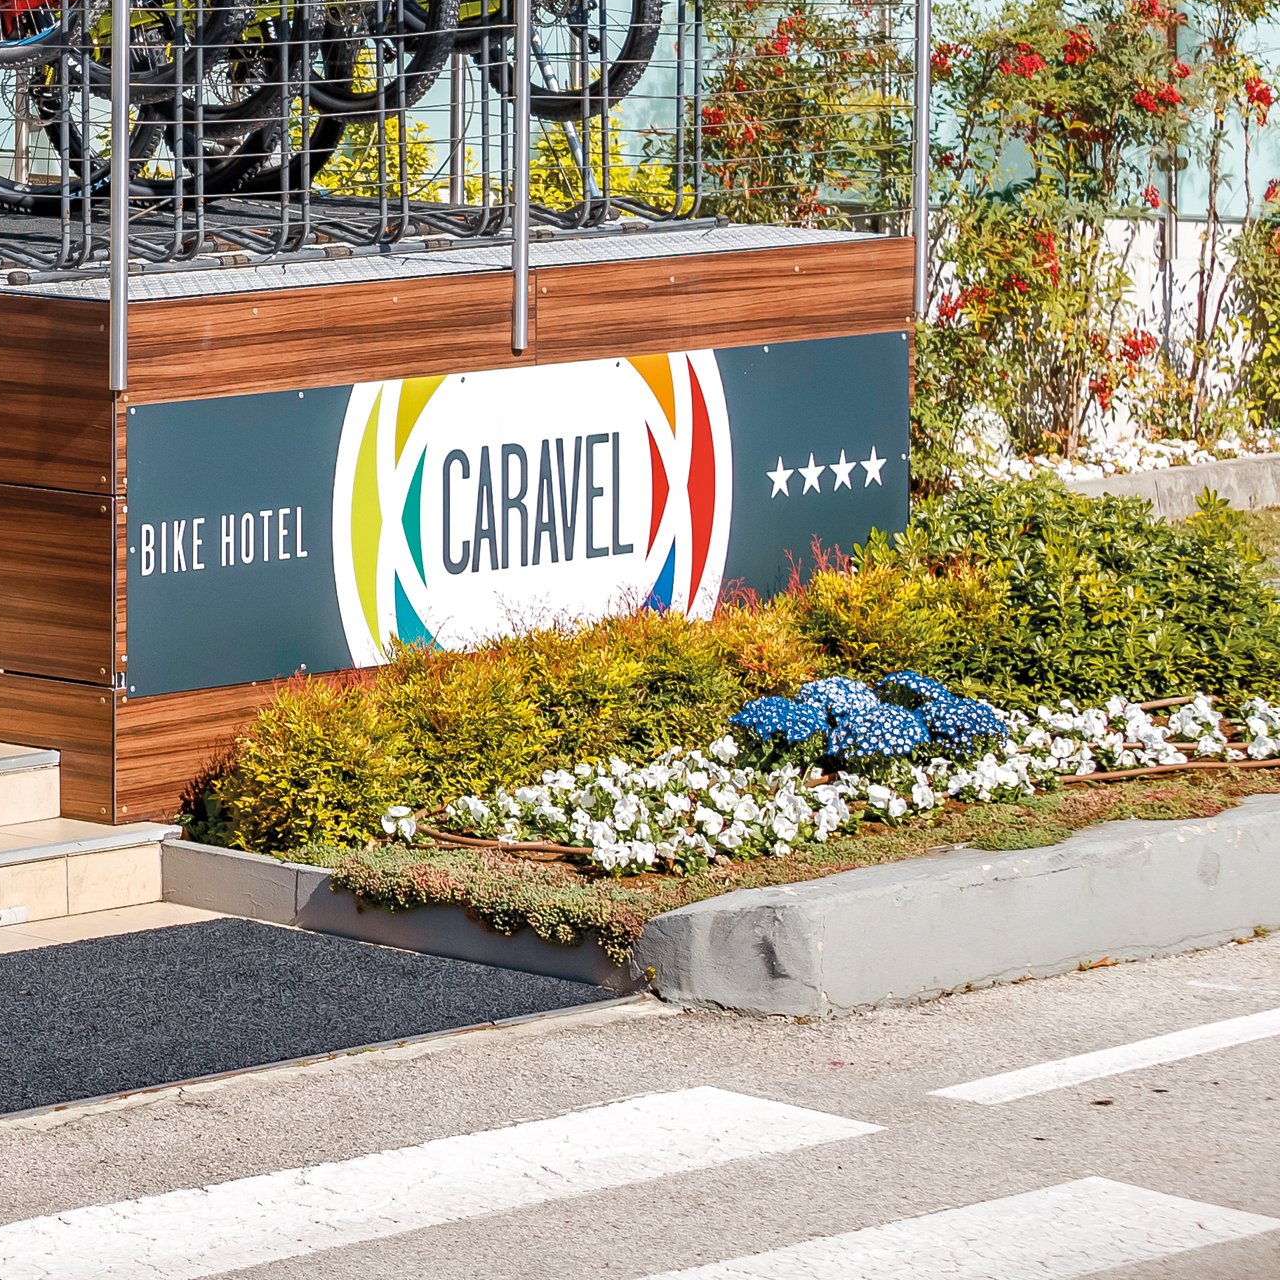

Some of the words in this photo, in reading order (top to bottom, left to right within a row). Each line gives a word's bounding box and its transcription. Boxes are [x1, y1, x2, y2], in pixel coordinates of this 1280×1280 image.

[141, 517, 205, 577] BIKE
[221, 506, 309, 567] HOTEL
[442, 432, 634, 575] CARAVEL
